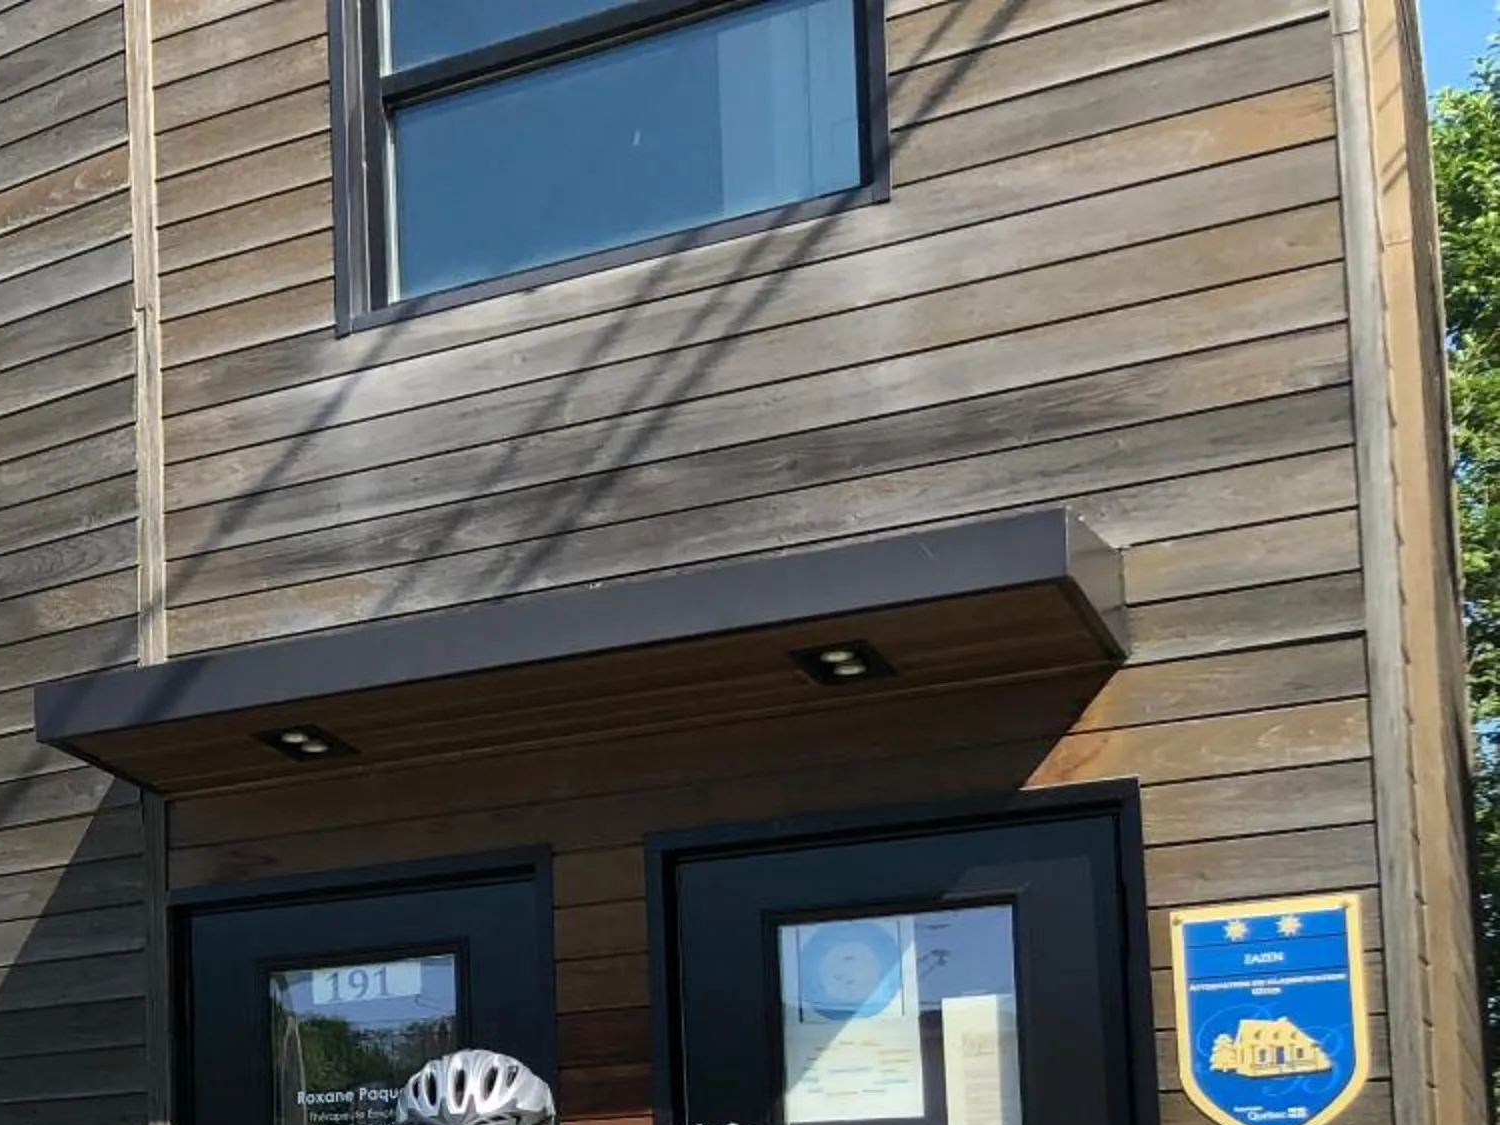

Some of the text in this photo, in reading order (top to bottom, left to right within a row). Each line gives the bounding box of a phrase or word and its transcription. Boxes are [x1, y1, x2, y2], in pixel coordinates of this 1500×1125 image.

[324, 966, 390, 1001] 191
[297, 1087, 402, 1105] Roxane Paqu
